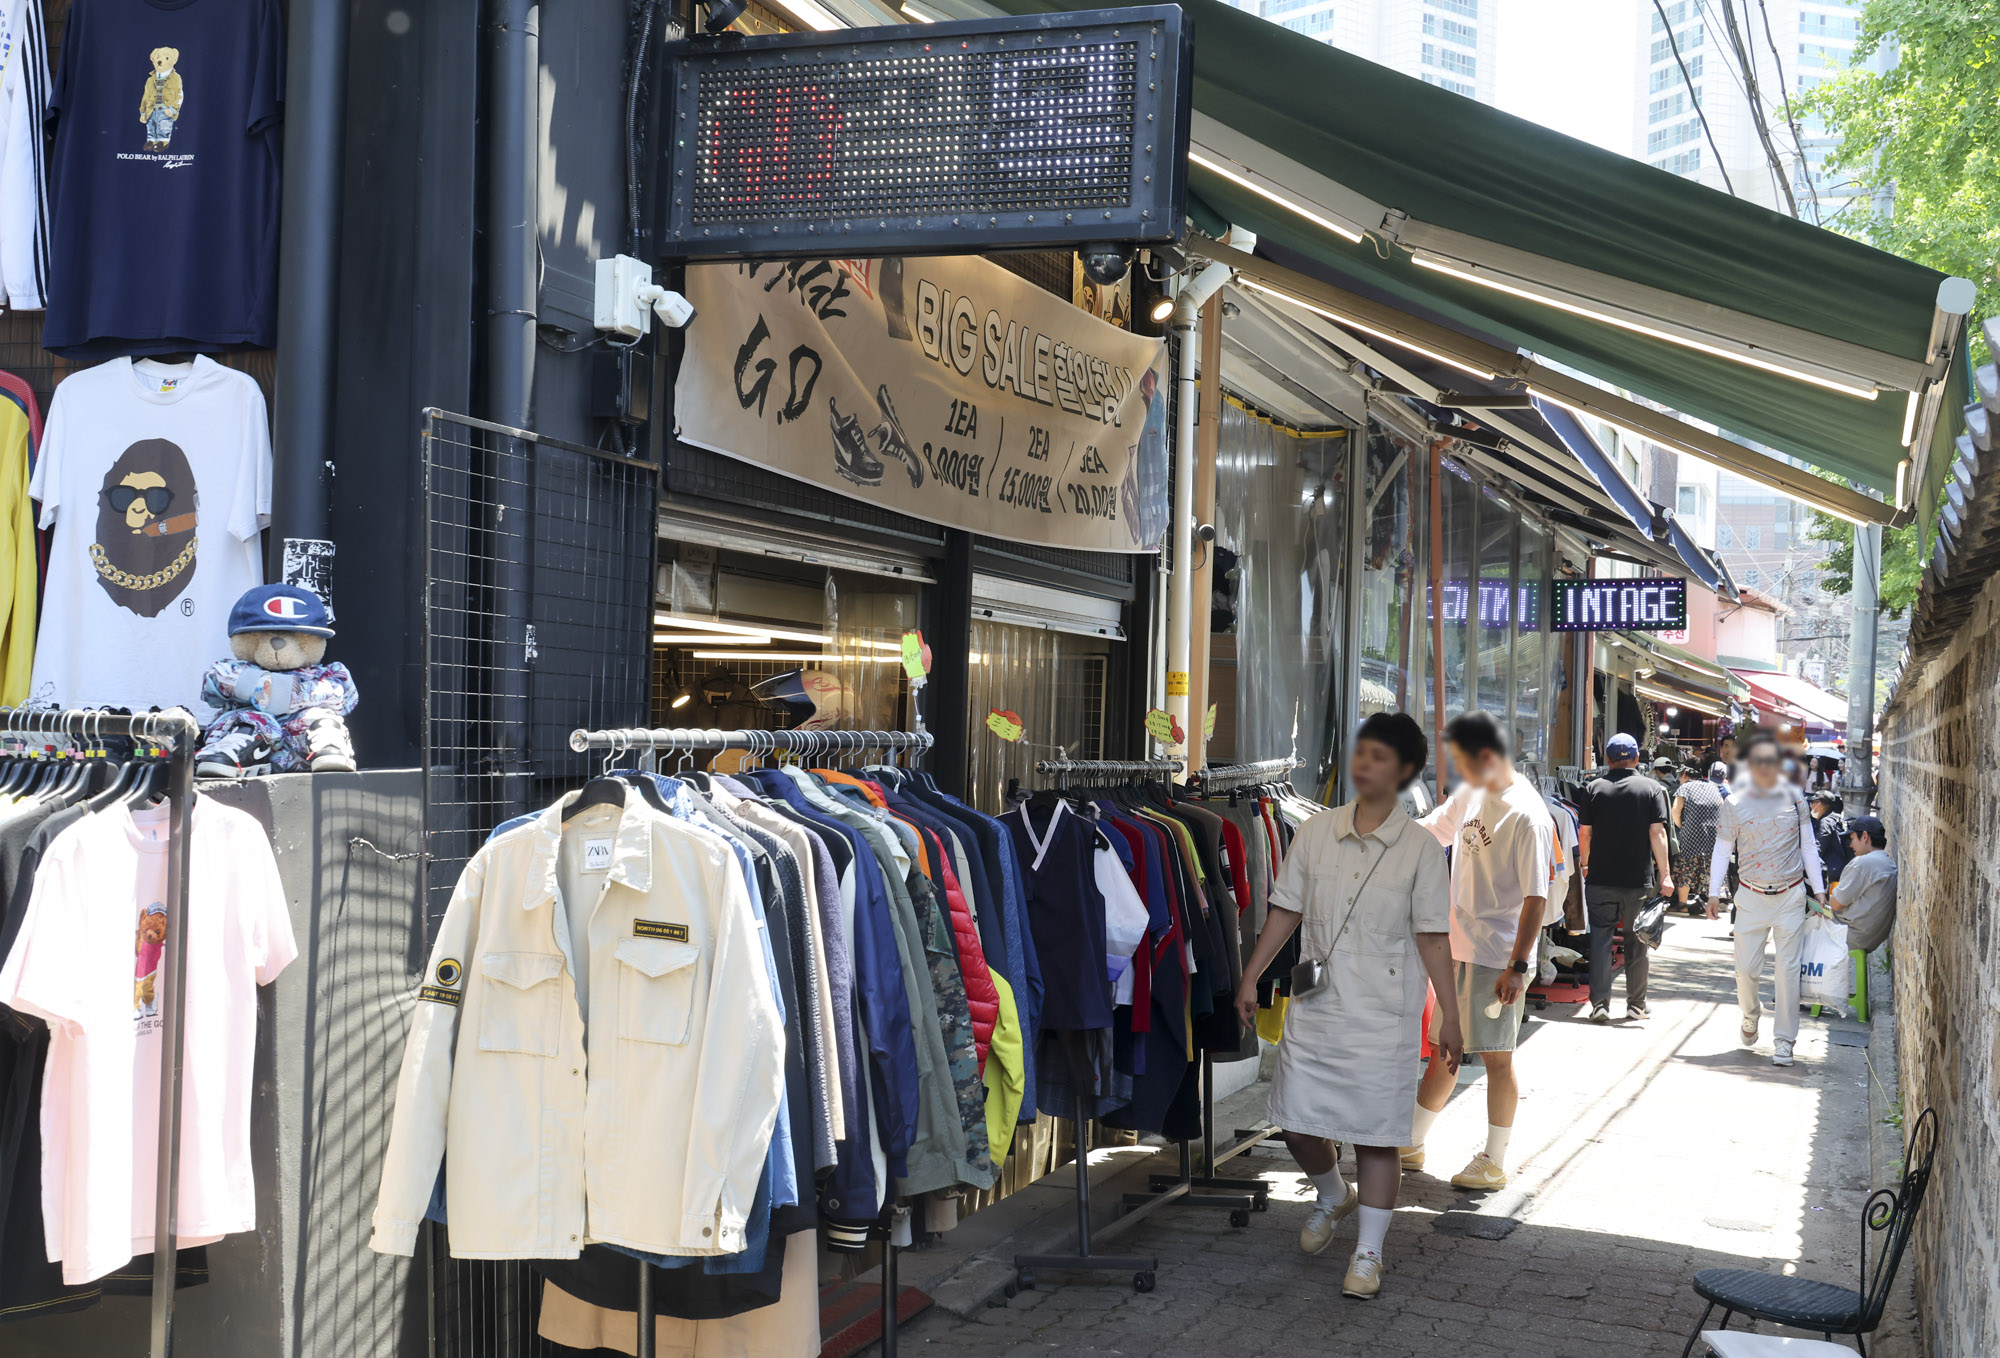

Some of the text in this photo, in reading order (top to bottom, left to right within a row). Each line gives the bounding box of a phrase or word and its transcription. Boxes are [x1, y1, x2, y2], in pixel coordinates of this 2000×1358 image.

[916, 278, 978, 376] BIG
[982, 309, 1054, 406] SALE
[945, 398, 978, 440] 1EA
[1027, 425, 1050, 463] 2EA
[922, 442, 984, 497] 8,000원
[998, 466, 1053, 514] 15,000원
[1567, 587, 1679, 622] INTAGE
[588, 846, 609, 856] ZARA
[1479, 826, 1492, 847] Ball
